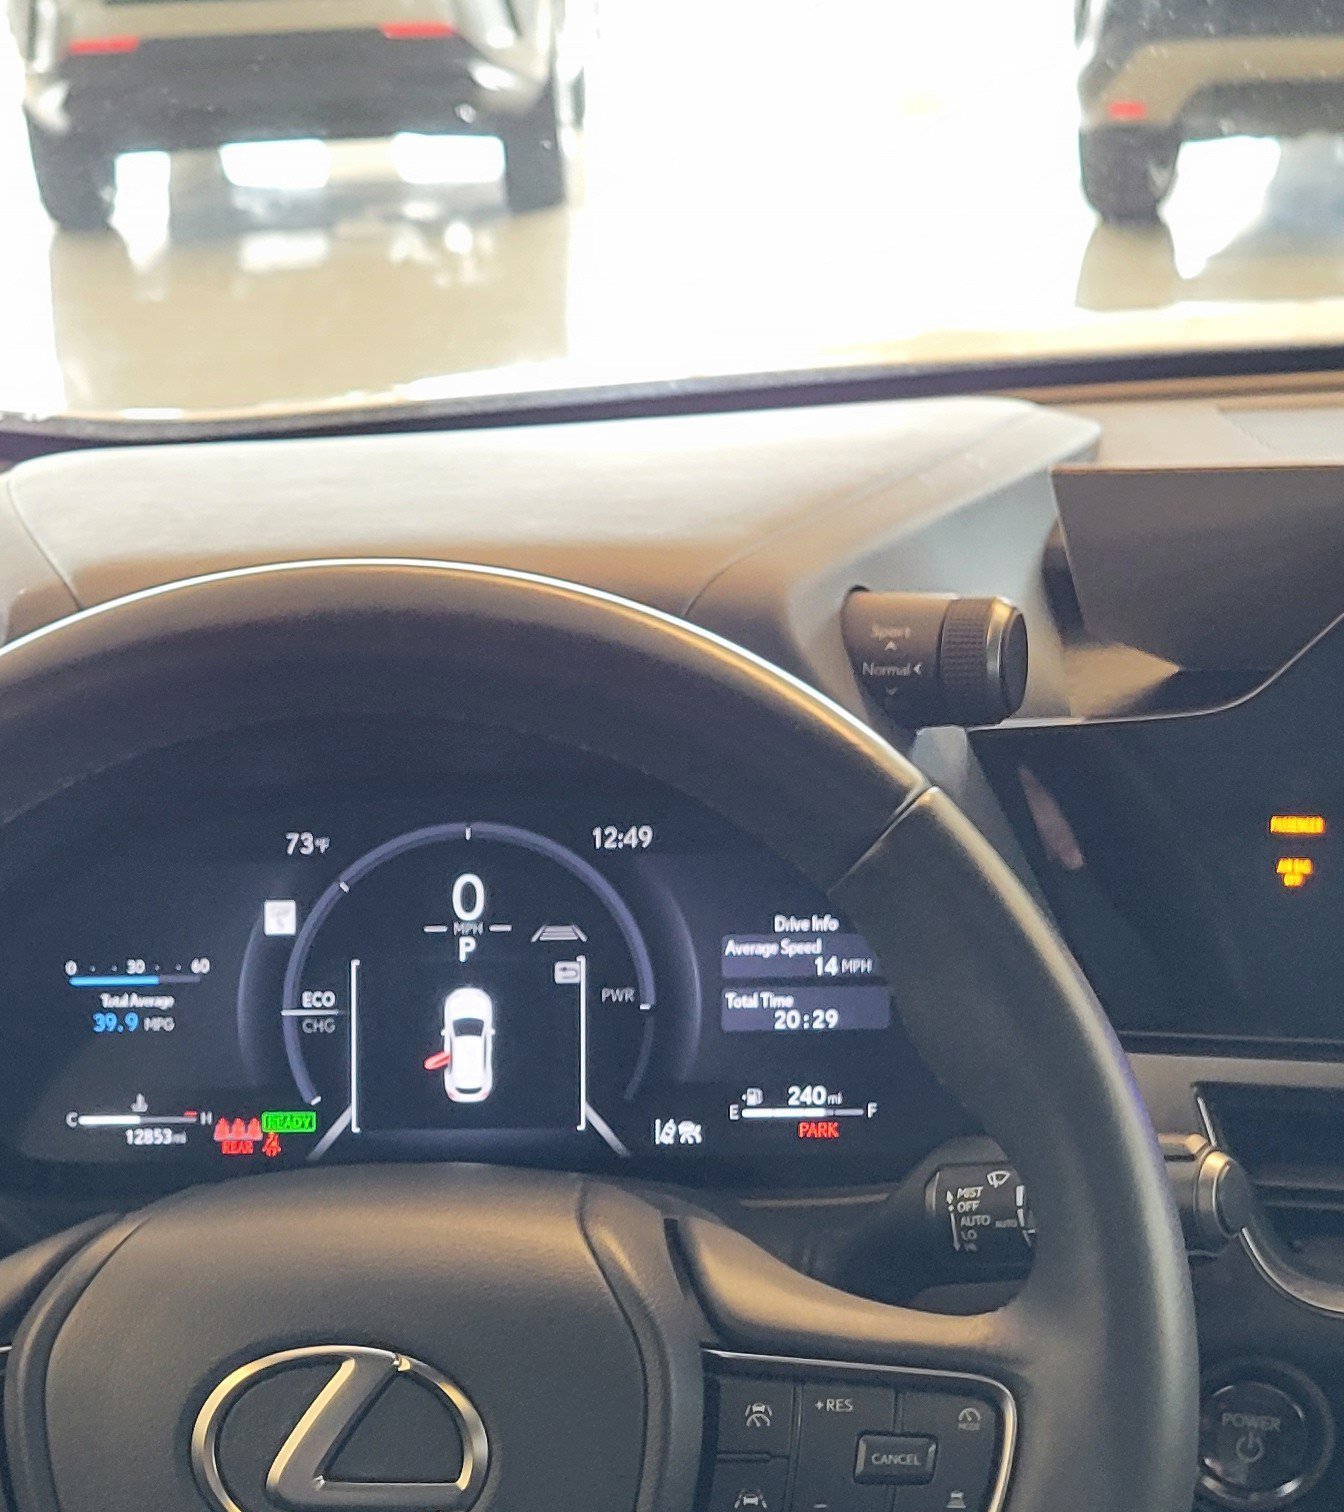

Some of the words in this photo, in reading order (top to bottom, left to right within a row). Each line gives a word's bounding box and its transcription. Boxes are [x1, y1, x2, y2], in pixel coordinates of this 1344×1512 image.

[862, 662, 910, 676] Normal
[592, 825, 653, 849] 12:49
[452, 873, 484, 921] 0
[453, 921, 483, 935] MPH
[774, 914, 810, 932] Drive
[812, 914, 839, 932] Info
[459, 936, 476, 962] P
[725, 939, 779, 958] Average
[781, 937, 822, 957] Speed
[126, 959, 146, 974] 30
[191, 957, 210, 974] 60
[814, 956, 838, 976] 14
[841, 957, 873, 973] MPH
[100, 992, 129, 1008] Total
[129, 992, 175, 1010] Average
[302, 991, 336, 1008] ECO
[601, 988, 635, 1002] PWR
[725, 991, 758, 1009] Total
[760, 991, 794, 1008] Time
[92, 1012, 139, 1032] 39.9
[143, 1016, 175, 1032] MPG
[302, 1018, 336, 1033] CHG
[774, 1008, 839, 1029] 20:29
[729, 1103, 739, 1120] E
[867, 1101, 878, 1118] F
[798, 1122, 840, 1138] PARK
[957, 1186, 983, 1199] MIST
[957, 1200, 980, 1213] OFF
[960, 1215, 991, 1226] AUTO
[871, 1452, 921, 1466] CANCEL
